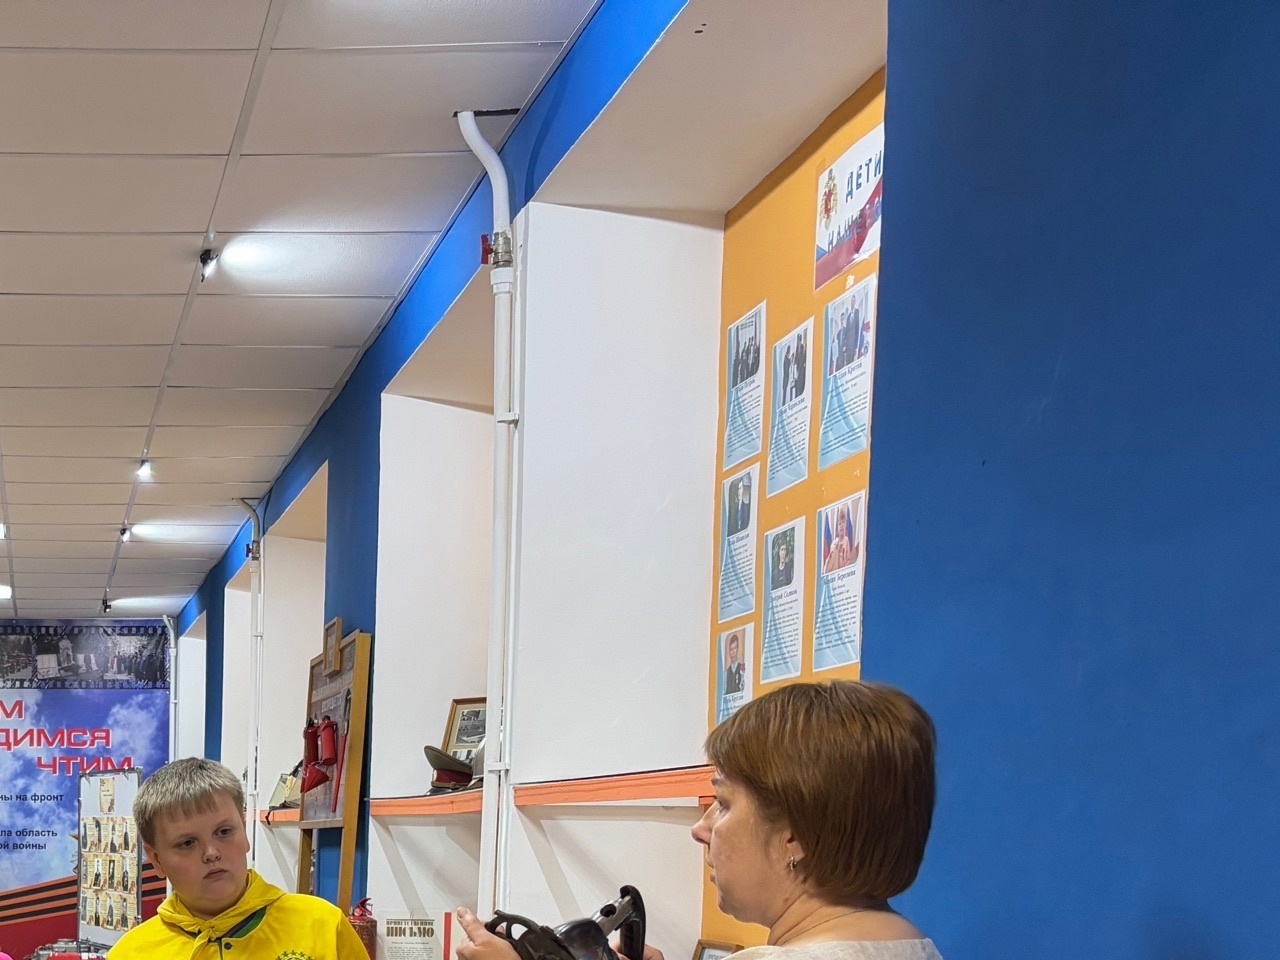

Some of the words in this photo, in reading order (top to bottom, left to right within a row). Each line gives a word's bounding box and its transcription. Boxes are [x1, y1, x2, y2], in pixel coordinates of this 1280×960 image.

[846, 150, 882, 203] ДЕТИ
[37, 757, 133, 775] ЧТИМ
[30, 792, 64, 803] фронт
[15, 828, 57, 837] область
[12, 841, 47, 850] войны
[386, 927, 434, 937] ПИСЬМО
